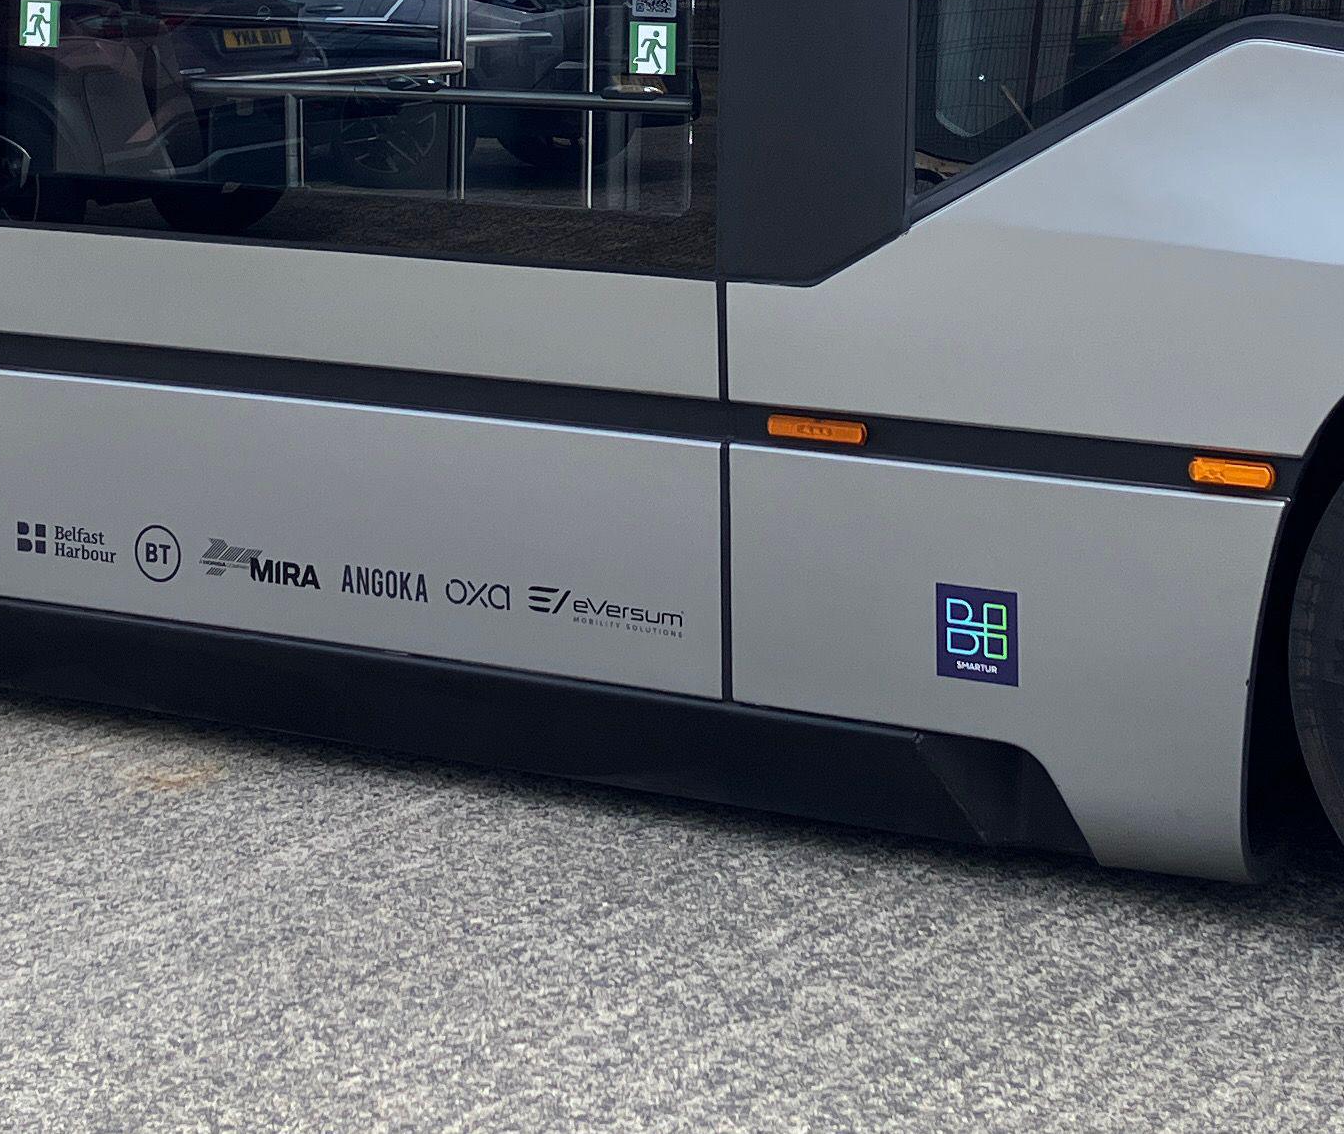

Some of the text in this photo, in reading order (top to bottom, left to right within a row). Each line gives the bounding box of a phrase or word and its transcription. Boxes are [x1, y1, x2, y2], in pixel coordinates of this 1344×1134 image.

[54, 525, 106, 546] Belfast
[54, 540, 118, 565] Harbour
[145, 542, 171, 565] BT
[249, 556, 321, 590] MIRA
[341, 564, 428, 603] ANGOKA
[572, 616, 683, 639] MOBILITY SOLUTIONS
